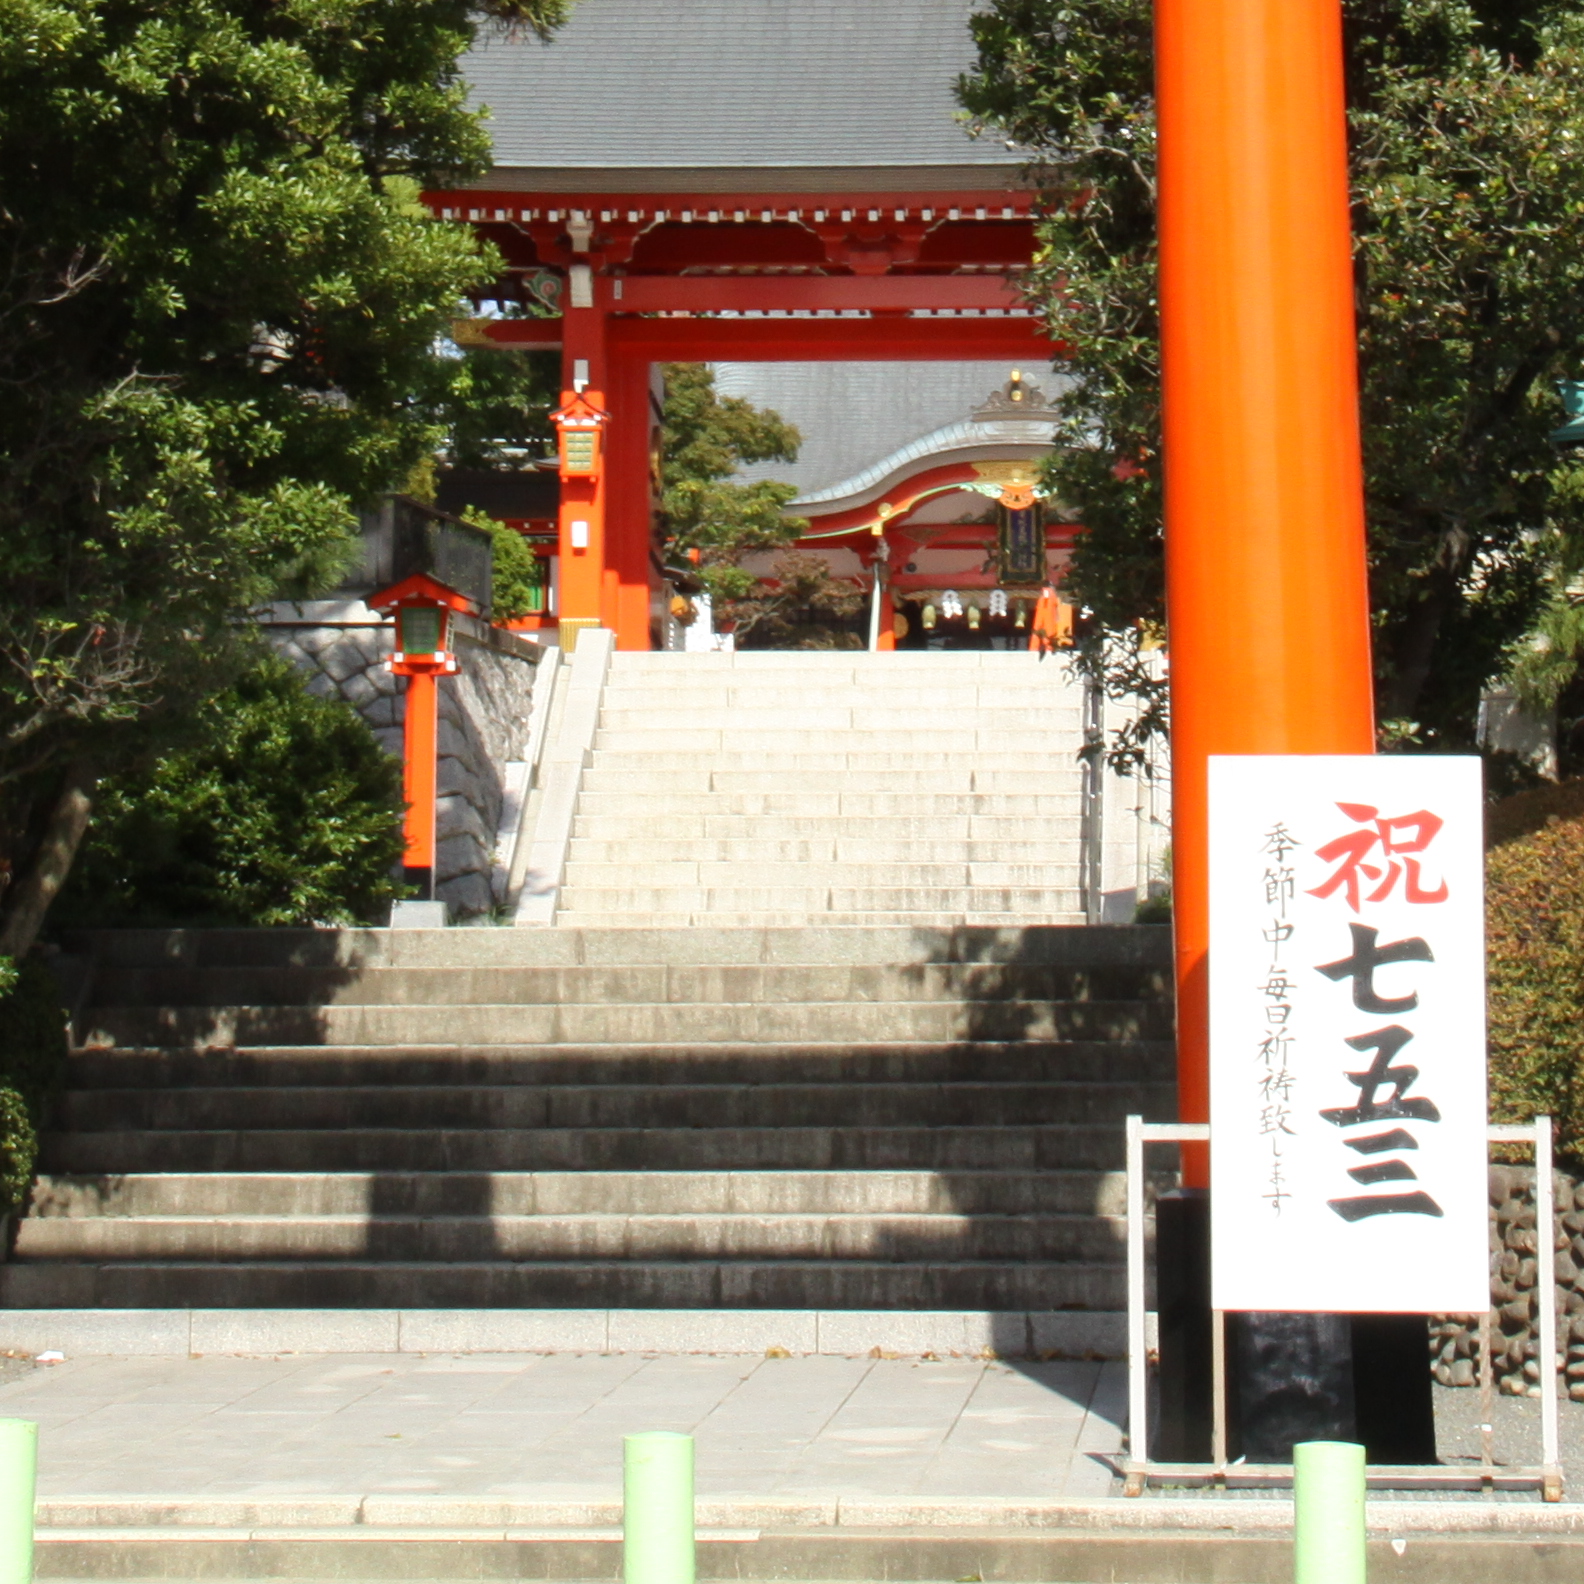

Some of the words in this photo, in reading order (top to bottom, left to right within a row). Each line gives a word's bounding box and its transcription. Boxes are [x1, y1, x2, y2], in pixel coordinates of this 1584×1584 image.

[1253, 821, 1302, 1218] 季節中毎日祈祷致します
